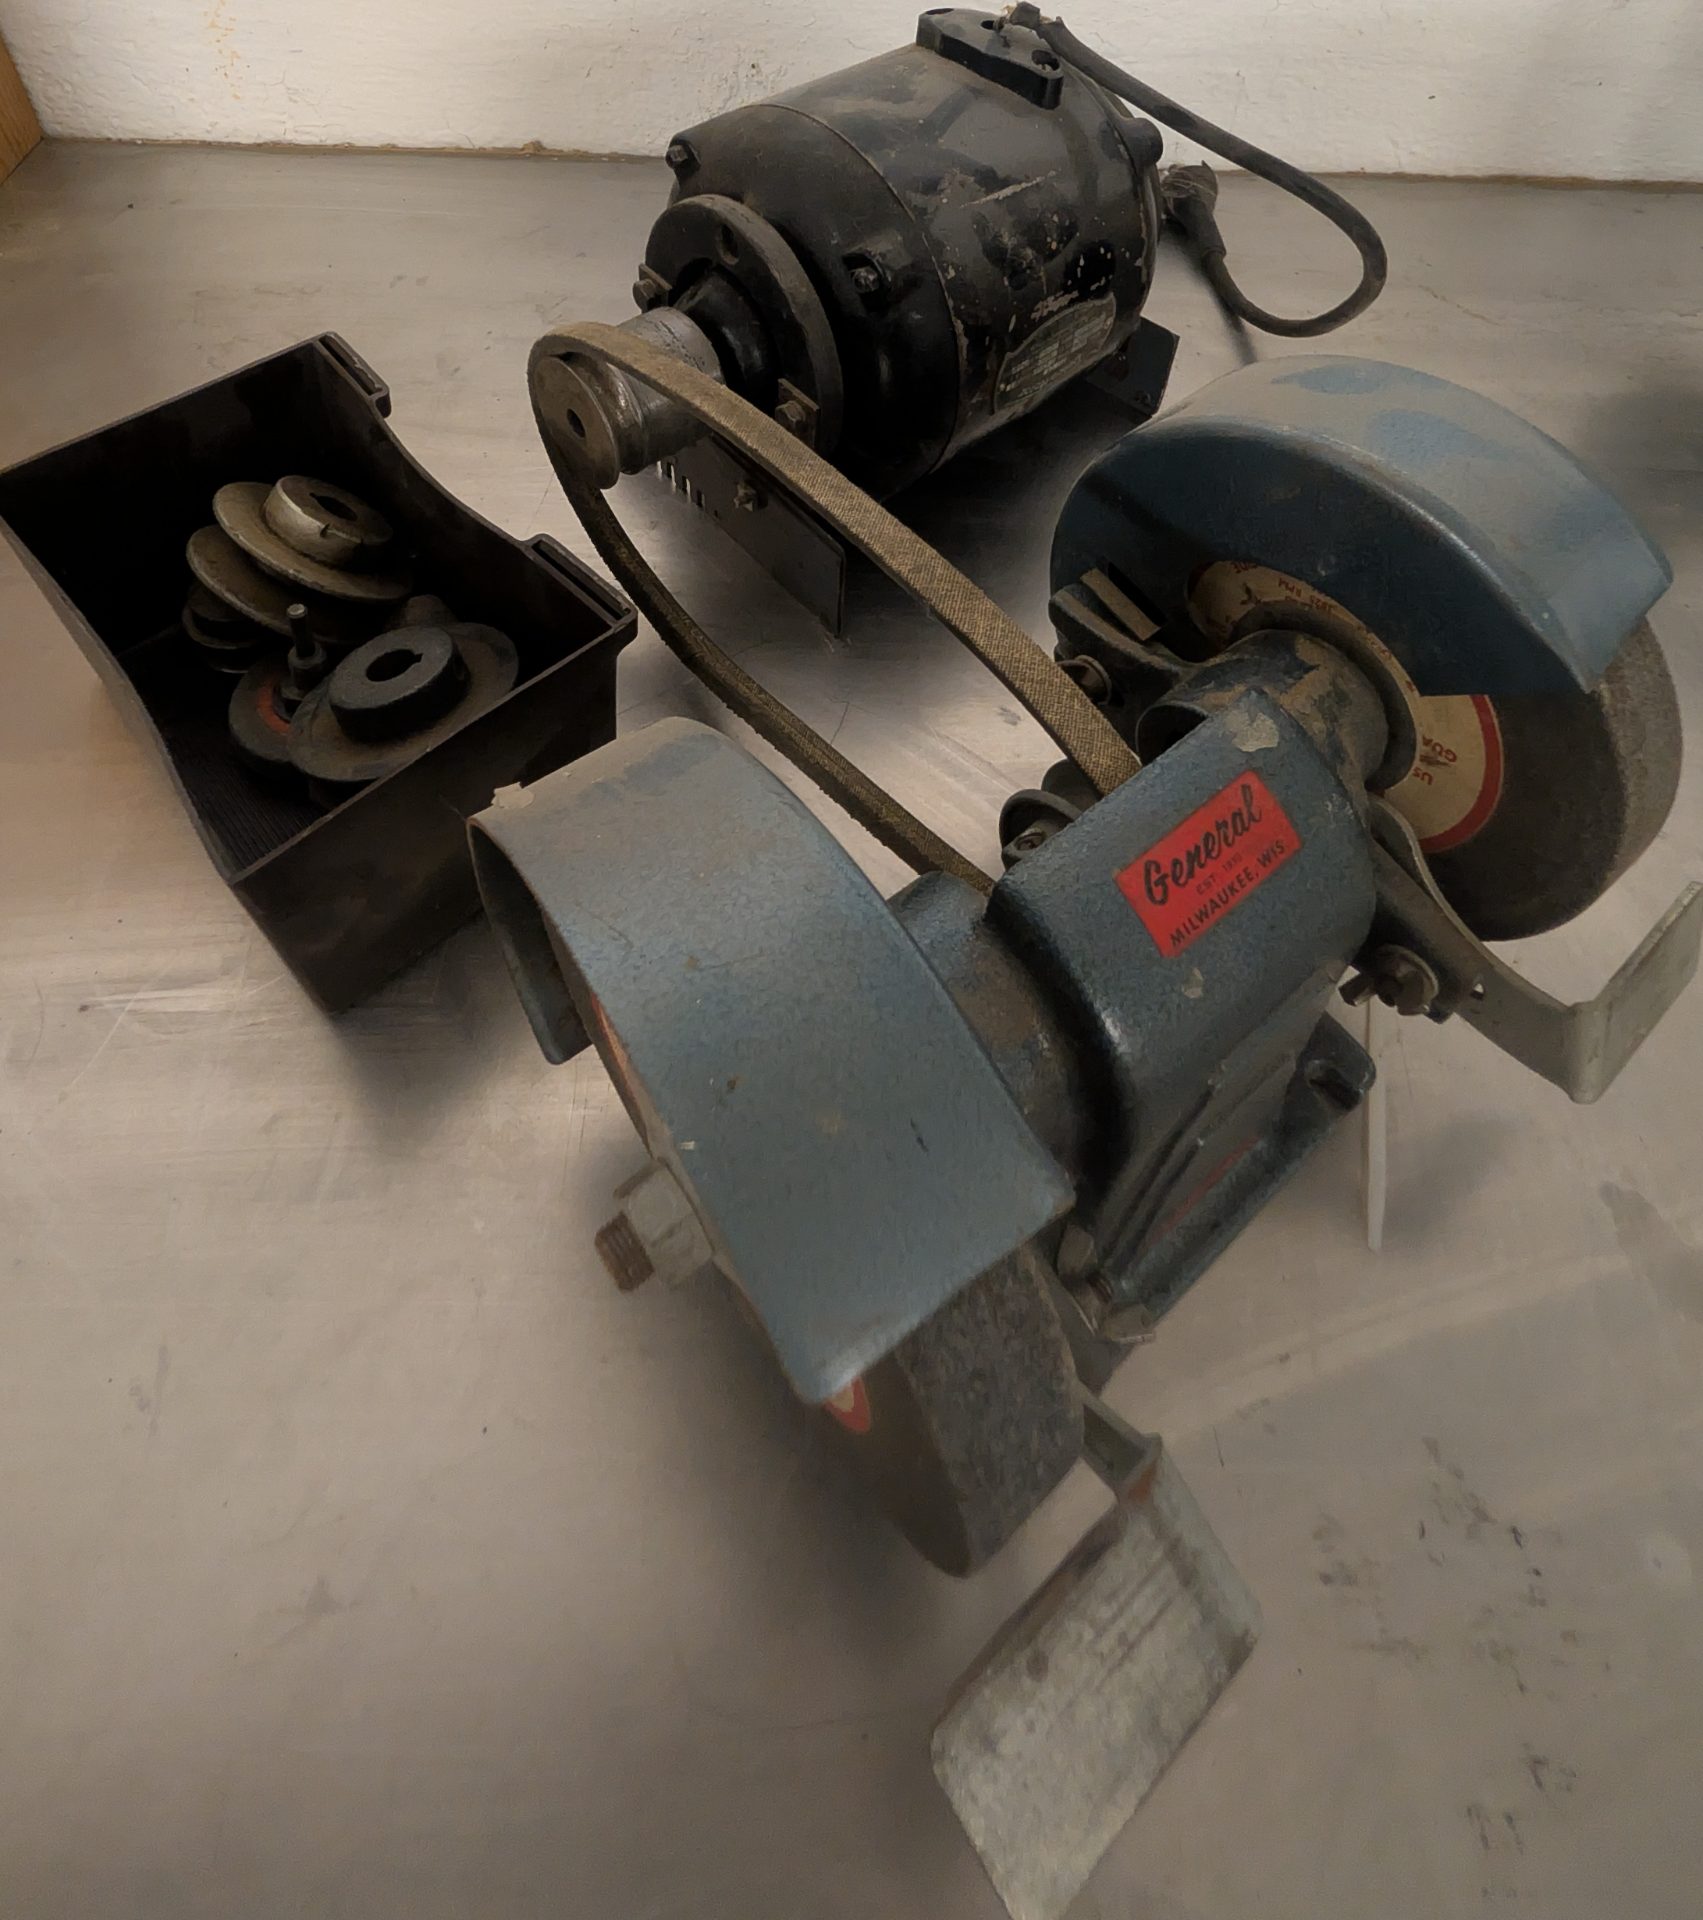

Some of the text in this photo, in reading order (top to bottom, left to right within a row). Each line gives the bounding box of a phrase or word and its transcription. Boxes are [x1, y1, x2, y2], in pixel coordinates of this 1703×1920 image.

[1143, 784, 1263, 906] General
[1170, 839, 1286, 948] MILWAUKEE, WIS
